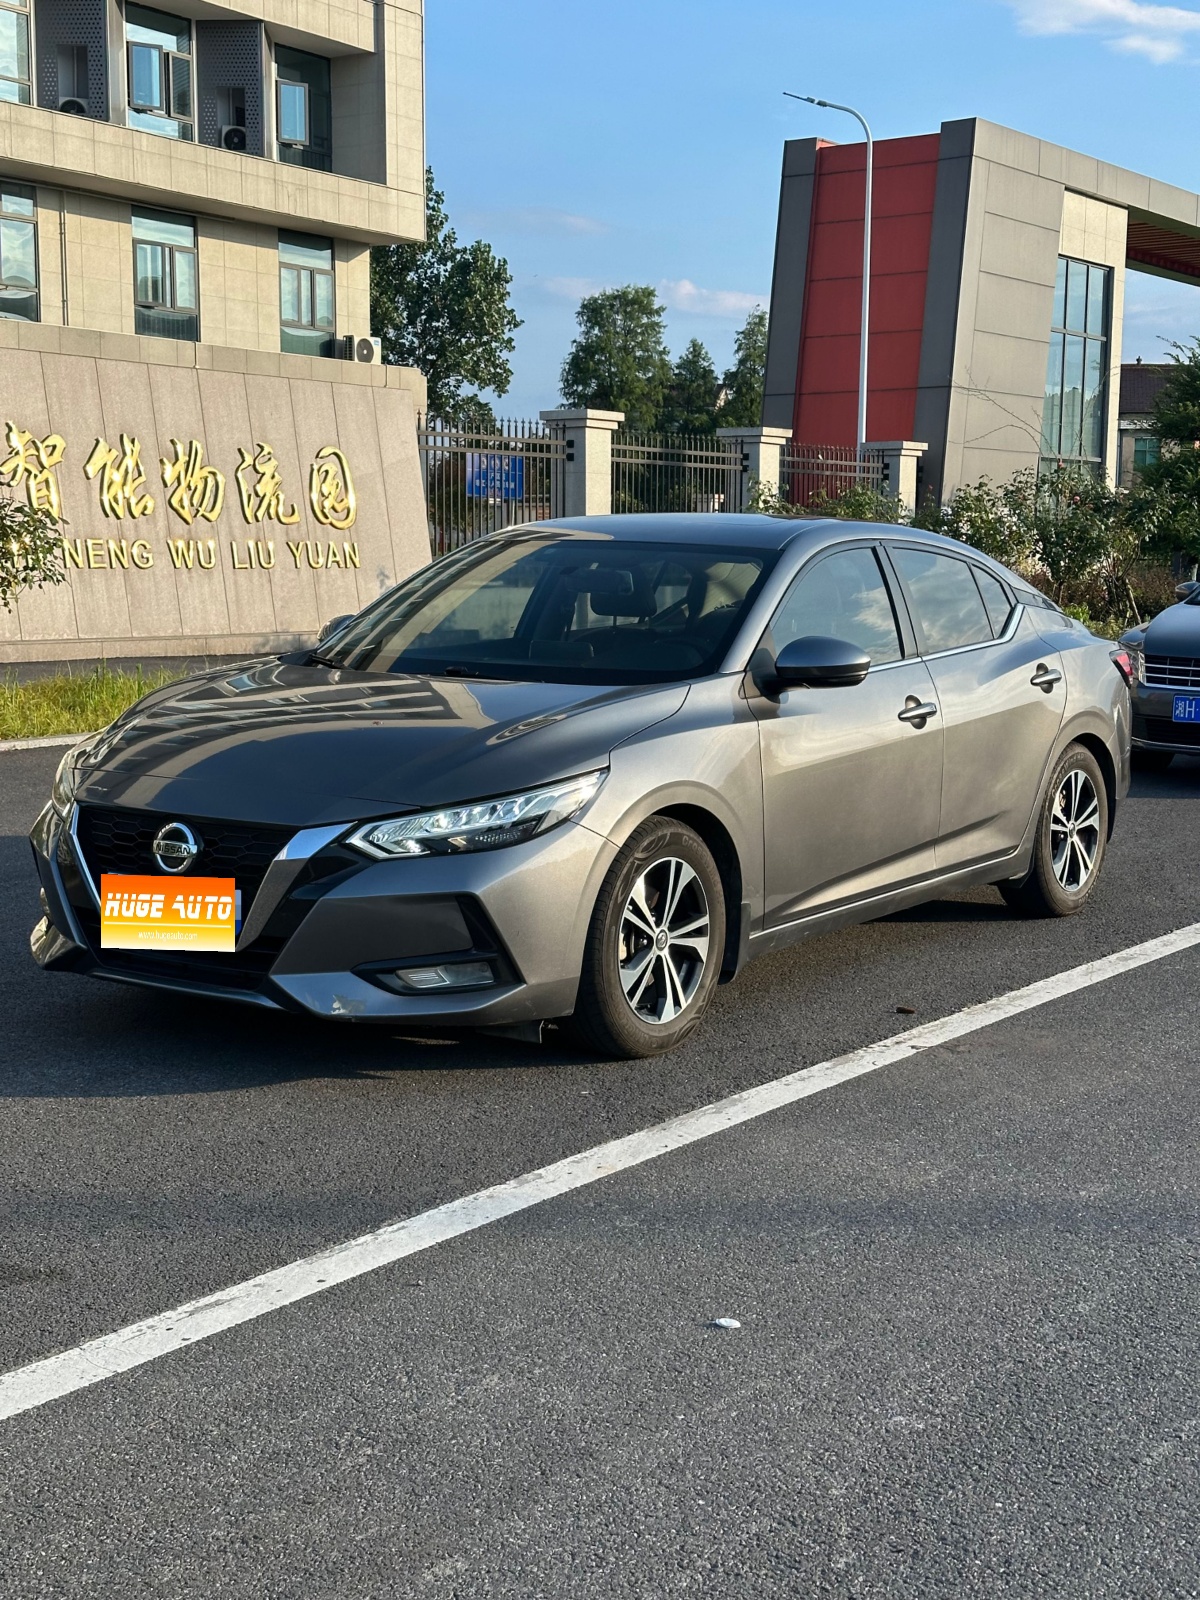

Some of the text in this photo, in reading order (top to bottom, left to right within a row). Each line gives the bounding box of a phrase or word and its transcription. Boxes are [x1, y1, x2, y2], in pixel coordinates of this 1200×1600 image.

[64, 538, 154, 569] NENG
[168, 538, 217, 569] WU
[232, 539, 276, 569] LIU
[288, 540, 360, 569] YUAN
[155, 842, 191, 855] NISSAN
